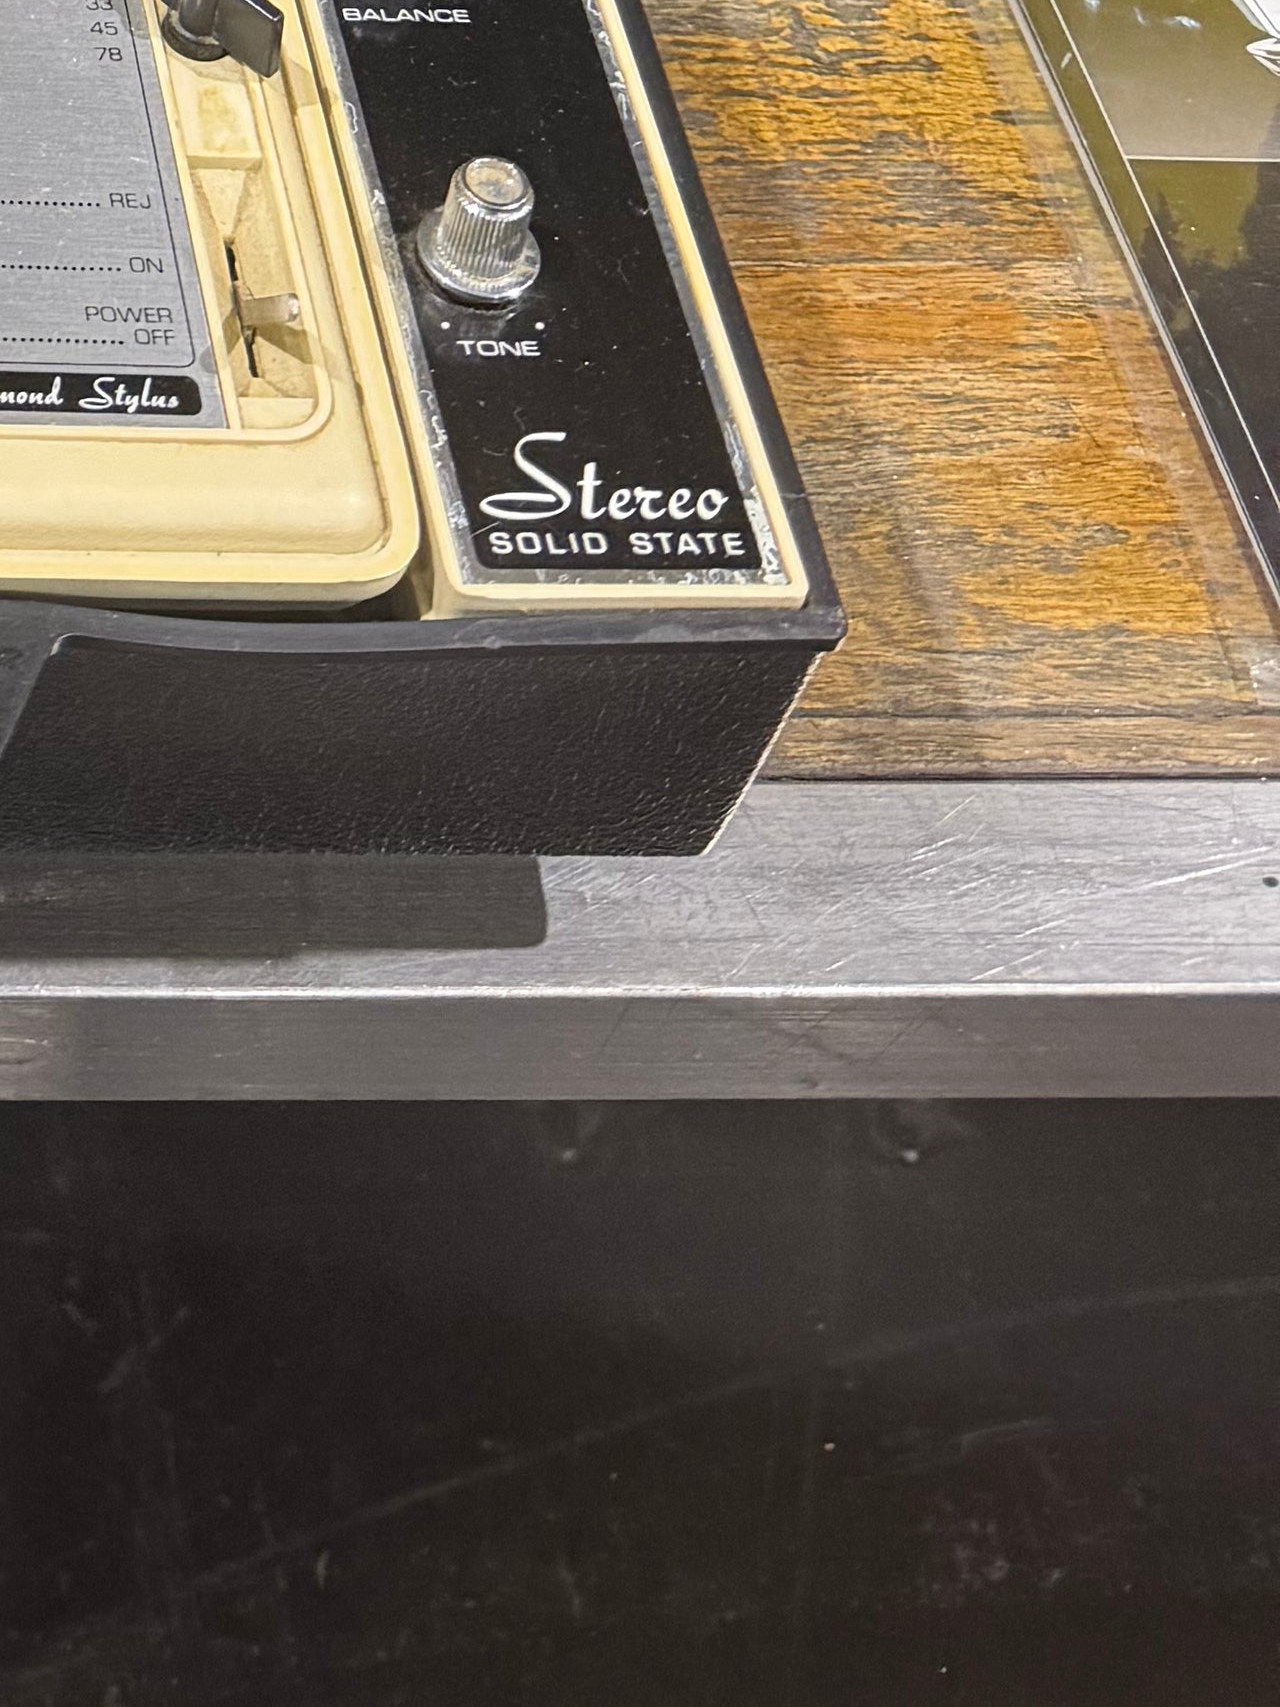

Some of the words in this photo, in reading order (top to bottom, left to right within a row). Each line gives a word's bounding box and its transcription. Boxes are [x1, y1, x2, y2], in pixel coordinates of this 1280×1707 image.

[342, 7, 471, 23] BALANCE
[90, 21, 118, 36] 45
[95, 47, 123, 62] 78
[109, 193, 152, 209] REJ
[129, 258, 163, 274] ON
[85, 306, 173, 323] POWER
[134, 328, 175, 345] OFF
[456, 340, 540, 356] TONE
[78, 378, 180, 414] Stylus
[479, 431, 729, 521] Stereo
[490, 531, 608, 555] SOLID
[629, 531, 745, 557] STATE
